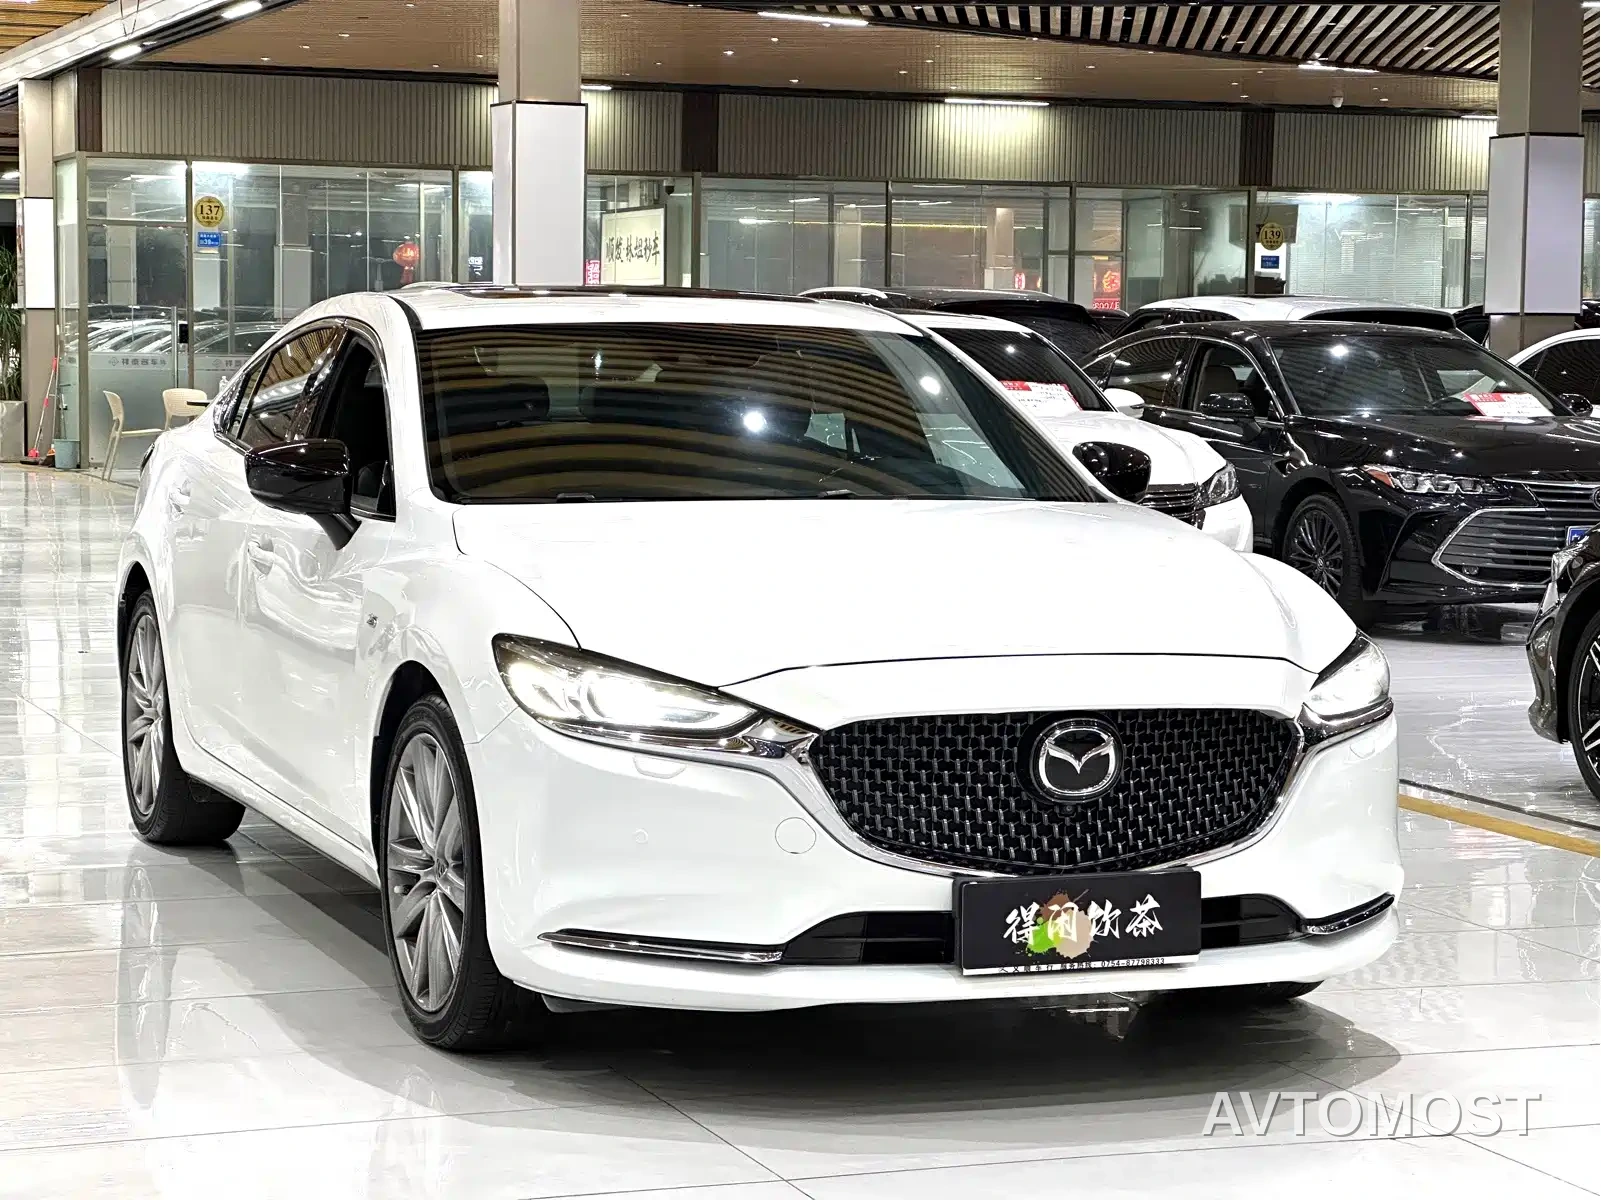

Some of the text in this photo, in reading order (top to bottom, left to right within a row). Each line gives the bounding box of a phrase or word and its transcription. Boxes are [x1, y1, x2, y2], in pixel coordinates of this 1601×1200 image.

[199, 204, 220, 215] 137
[1264, 230, 1281, 240] 139
[1003, 893, 1163, 946] 得闲饮茶
[1101, 957, 1165, 968] 0754-87798333
